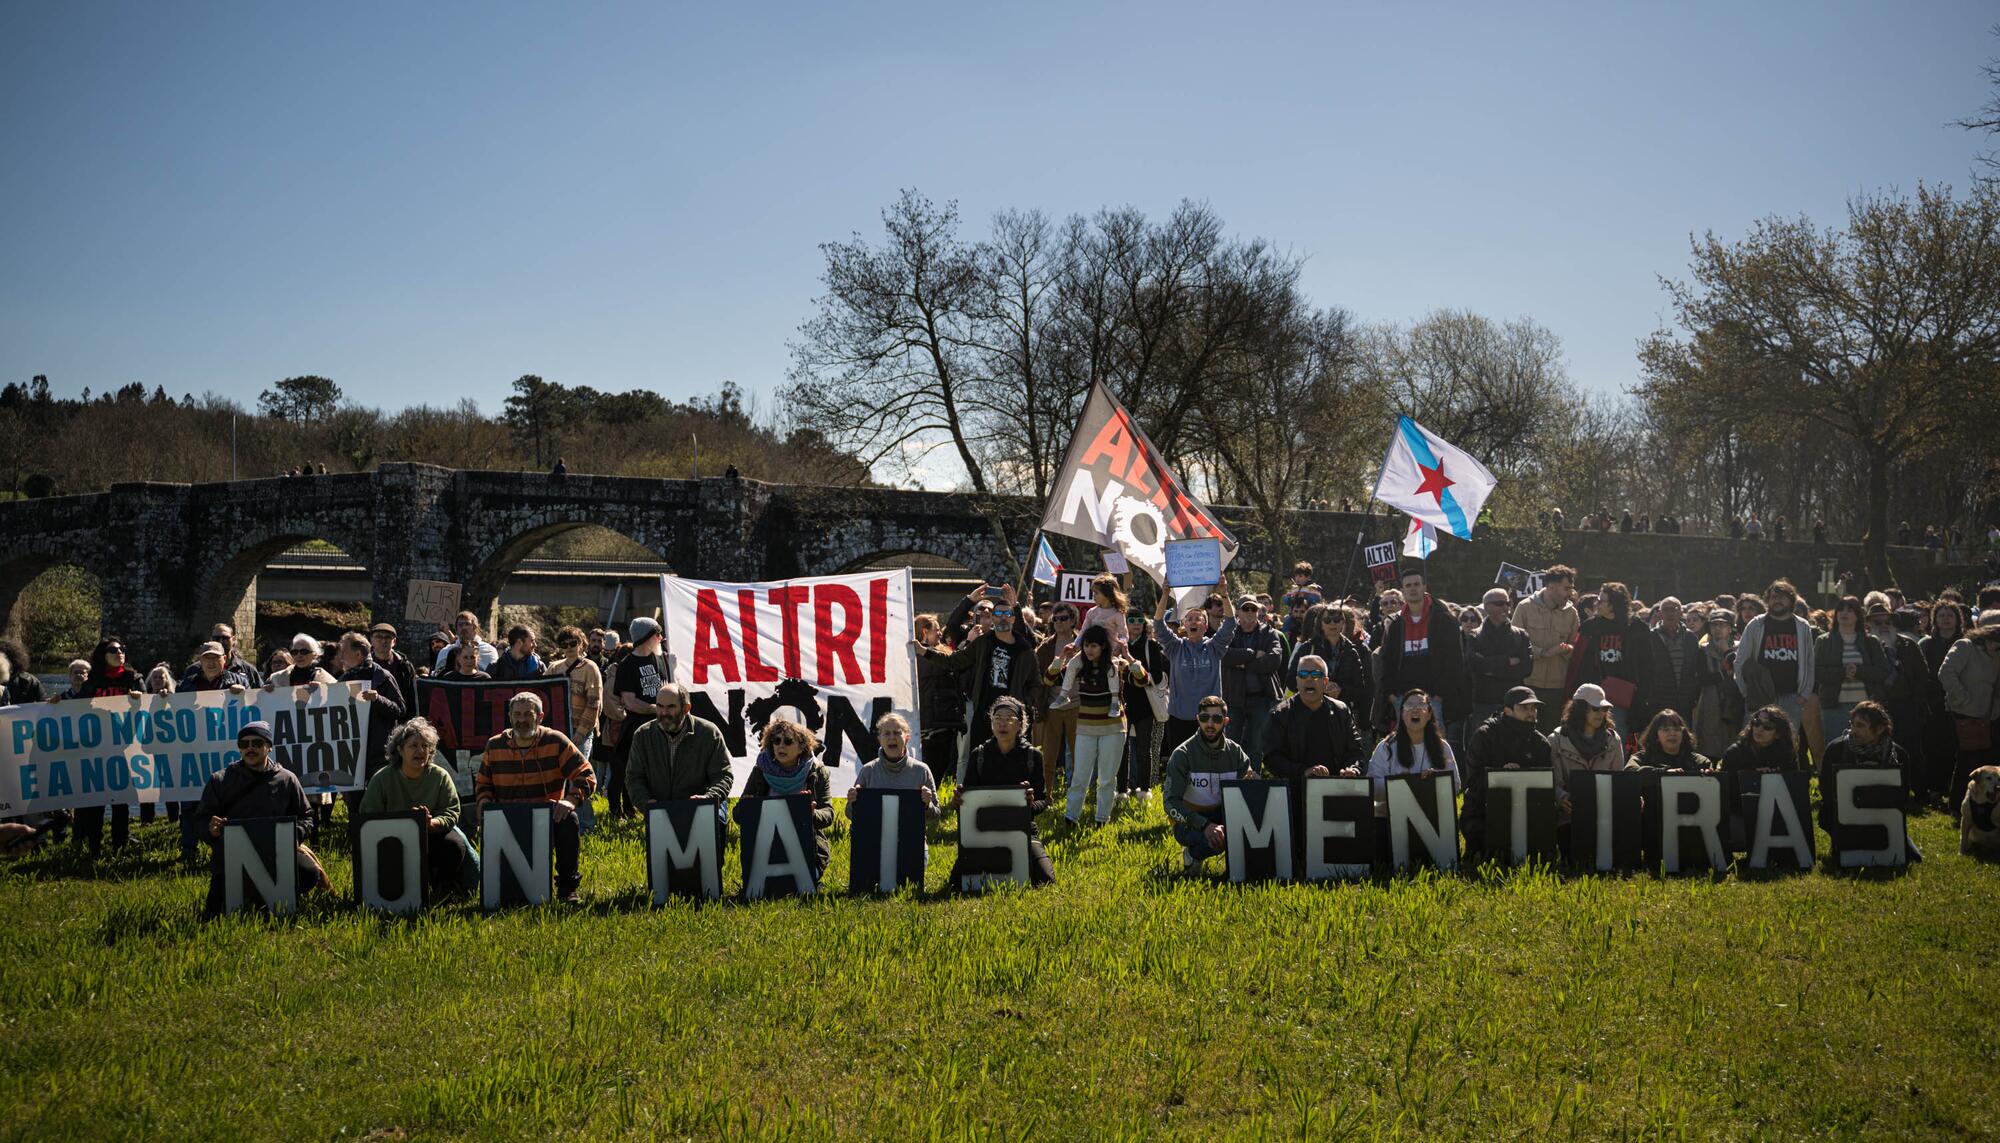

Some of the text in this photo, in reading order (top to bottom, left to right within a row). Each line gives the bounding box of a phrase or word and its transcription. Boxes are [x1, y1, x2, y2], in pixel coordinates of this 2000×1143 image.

[1061, 468, 1169, 578] NO
[1366, 544, 1394, 565] ALTRI
[412, 583, 459, 608] ALTRI
[1065, 577, 1095, 600] ALT
[413, 604, 458, 620] NON
[693, 579, 888, 685] ALTRI
[1764, 648, 1797, 661] NON
[1765, 633, 1797, 648] ALTRI
[12, 713, 102, 755] POLO
[110, 708, 197, 745] NOSO
[273, 703, 361, 745] ALTRI
[690, 678, 892, 768] NON
[20, 750, 241, 800] E A NOSA AU
[275, 738, 361, 778] NON
[223, 768, 1907, 914] NON MAIS MENTIRAS
